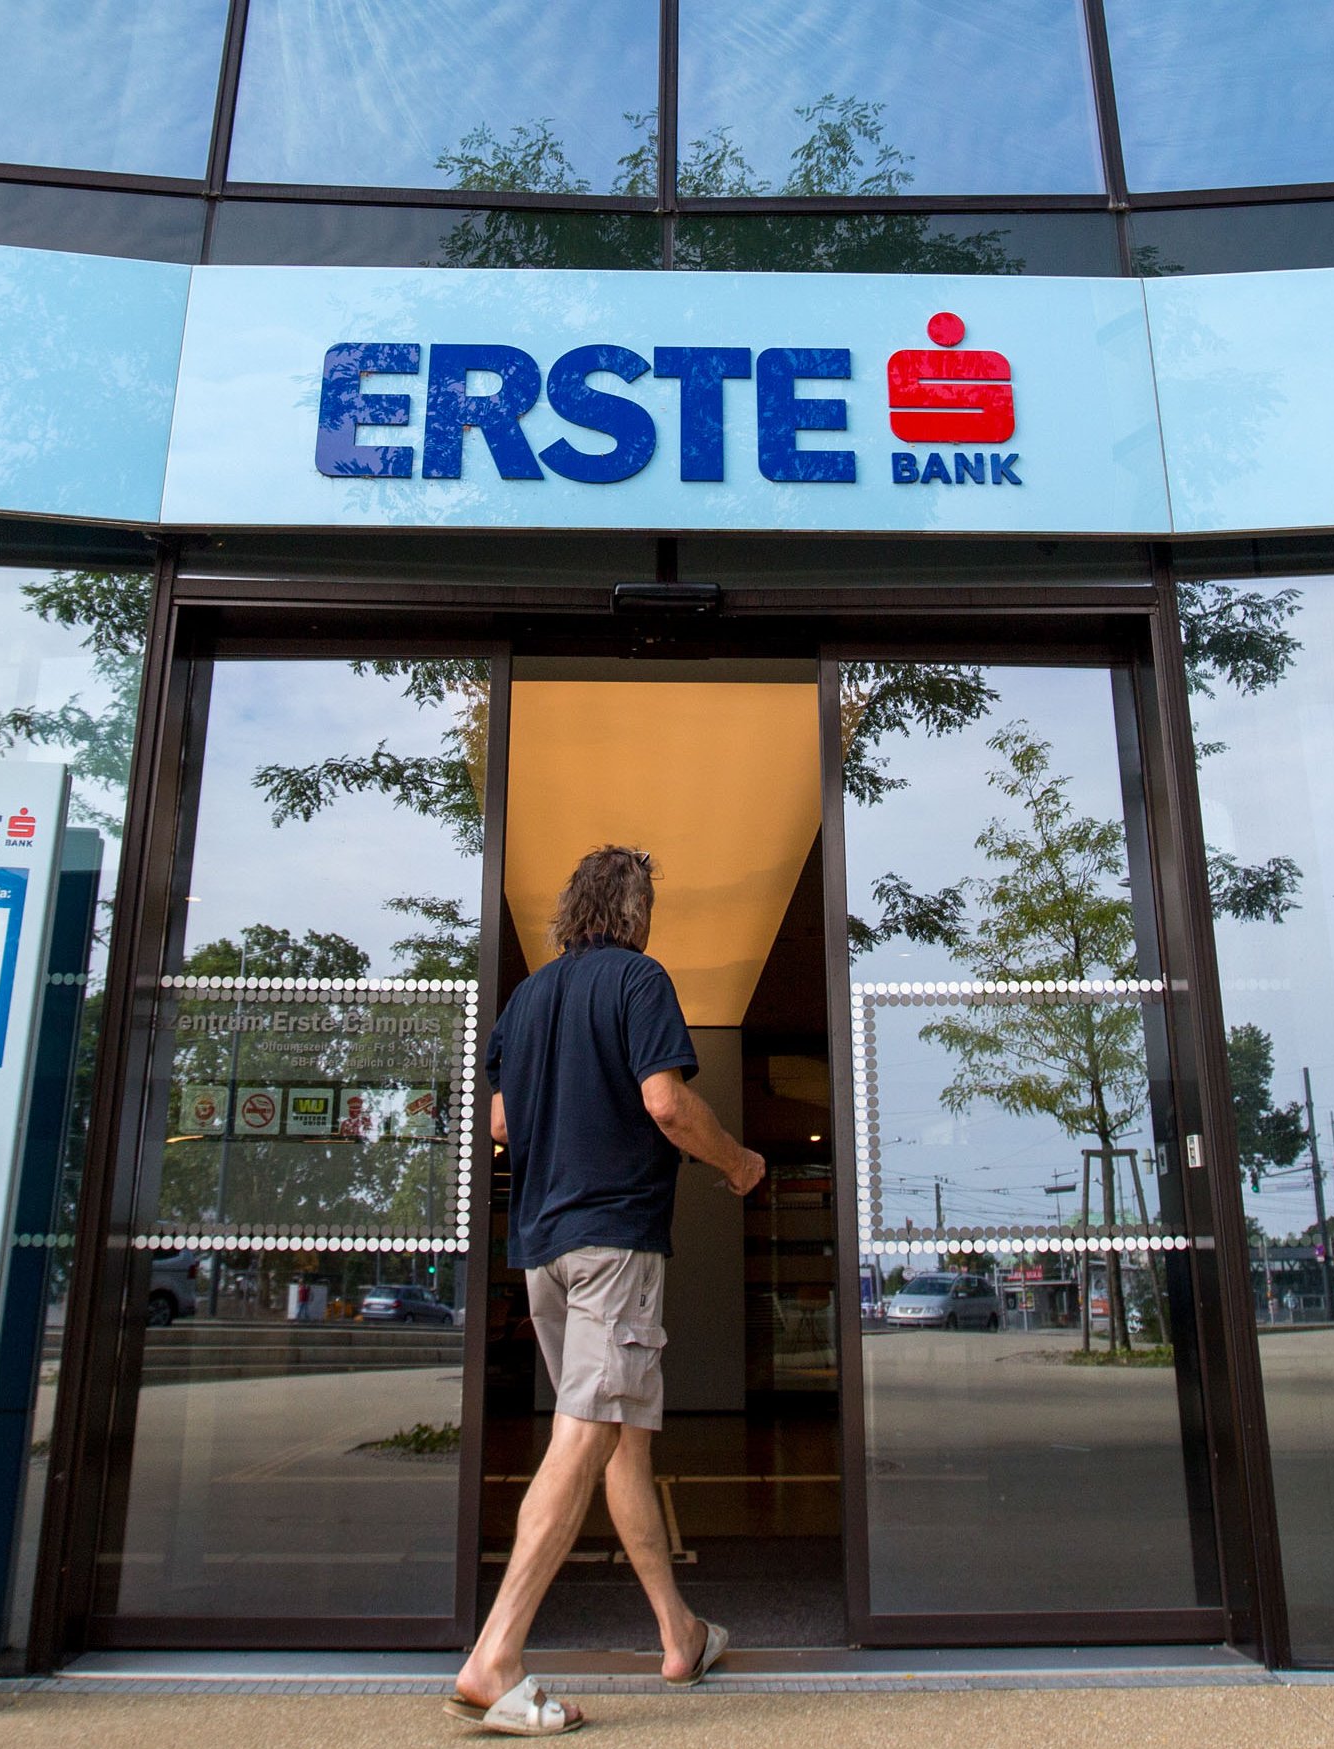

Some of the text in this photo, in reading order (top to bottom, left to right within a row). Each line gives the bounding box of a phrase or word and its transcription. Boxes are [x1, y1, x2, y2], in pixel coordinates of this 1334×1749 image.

[314, 342, 857, 483] ERSTE
[891, 451, 1023, 486] BANK
[5, 839, 33, 847] BANK
[273, 1010, 336, 1033] Erste
[344, 1010, 441, 1037] Campus
